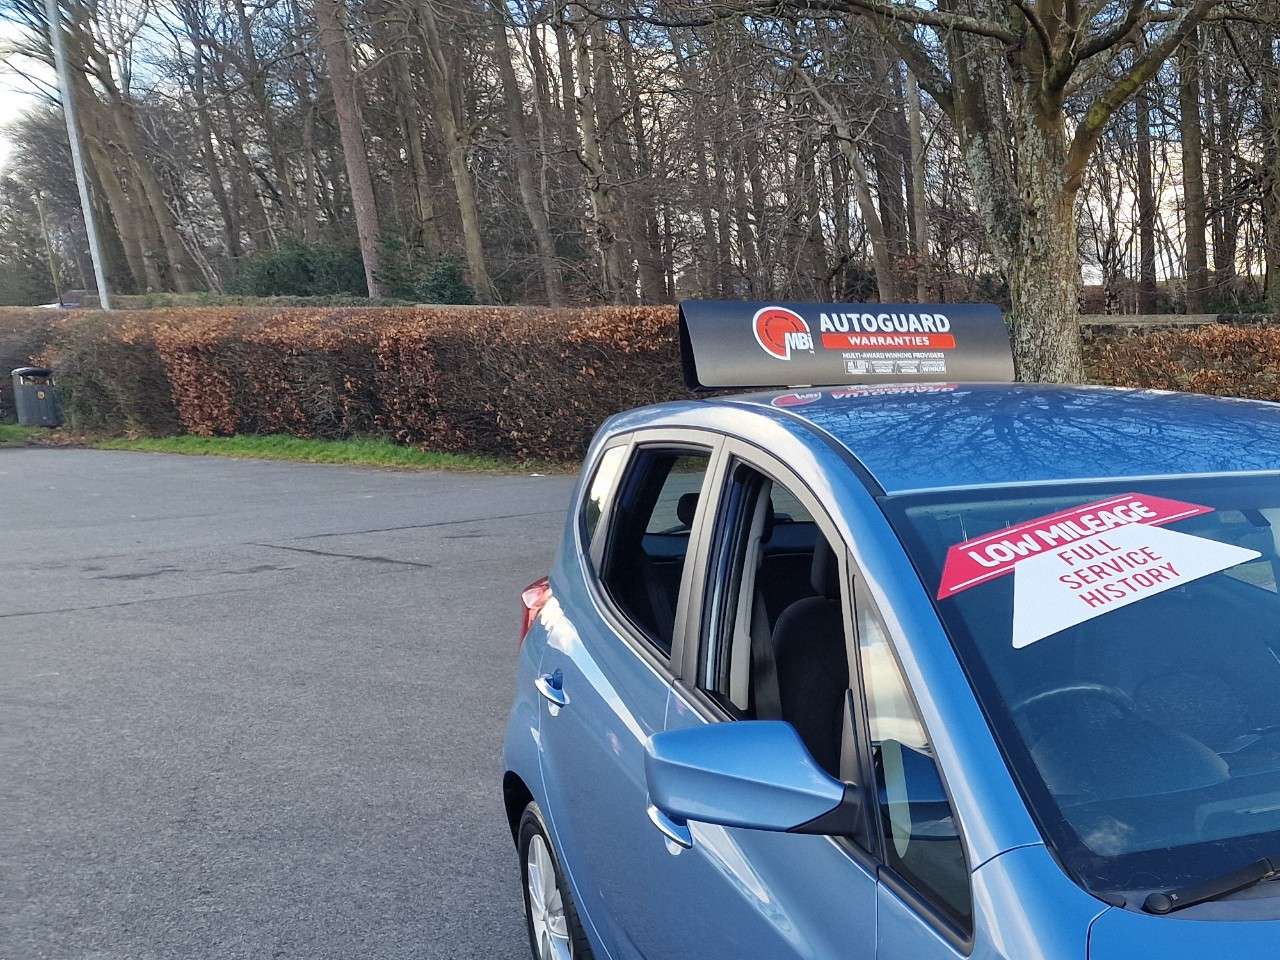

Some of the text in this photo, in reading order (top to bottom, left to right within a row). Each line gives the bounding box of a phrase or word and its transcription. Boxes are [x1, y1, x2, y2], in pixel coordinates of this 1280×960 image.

[820, 312, 951, 333] AUTOGUARD
[848, 335, 930, 346] WARRANTIES
[968, 501, 1157, 568] LOW MILEAGE
[1057, 539, 1121, 567] FULL
[1059, 546, 1162, 590] SERVICE
[1078, 562, 1181, 608] HISTORY
